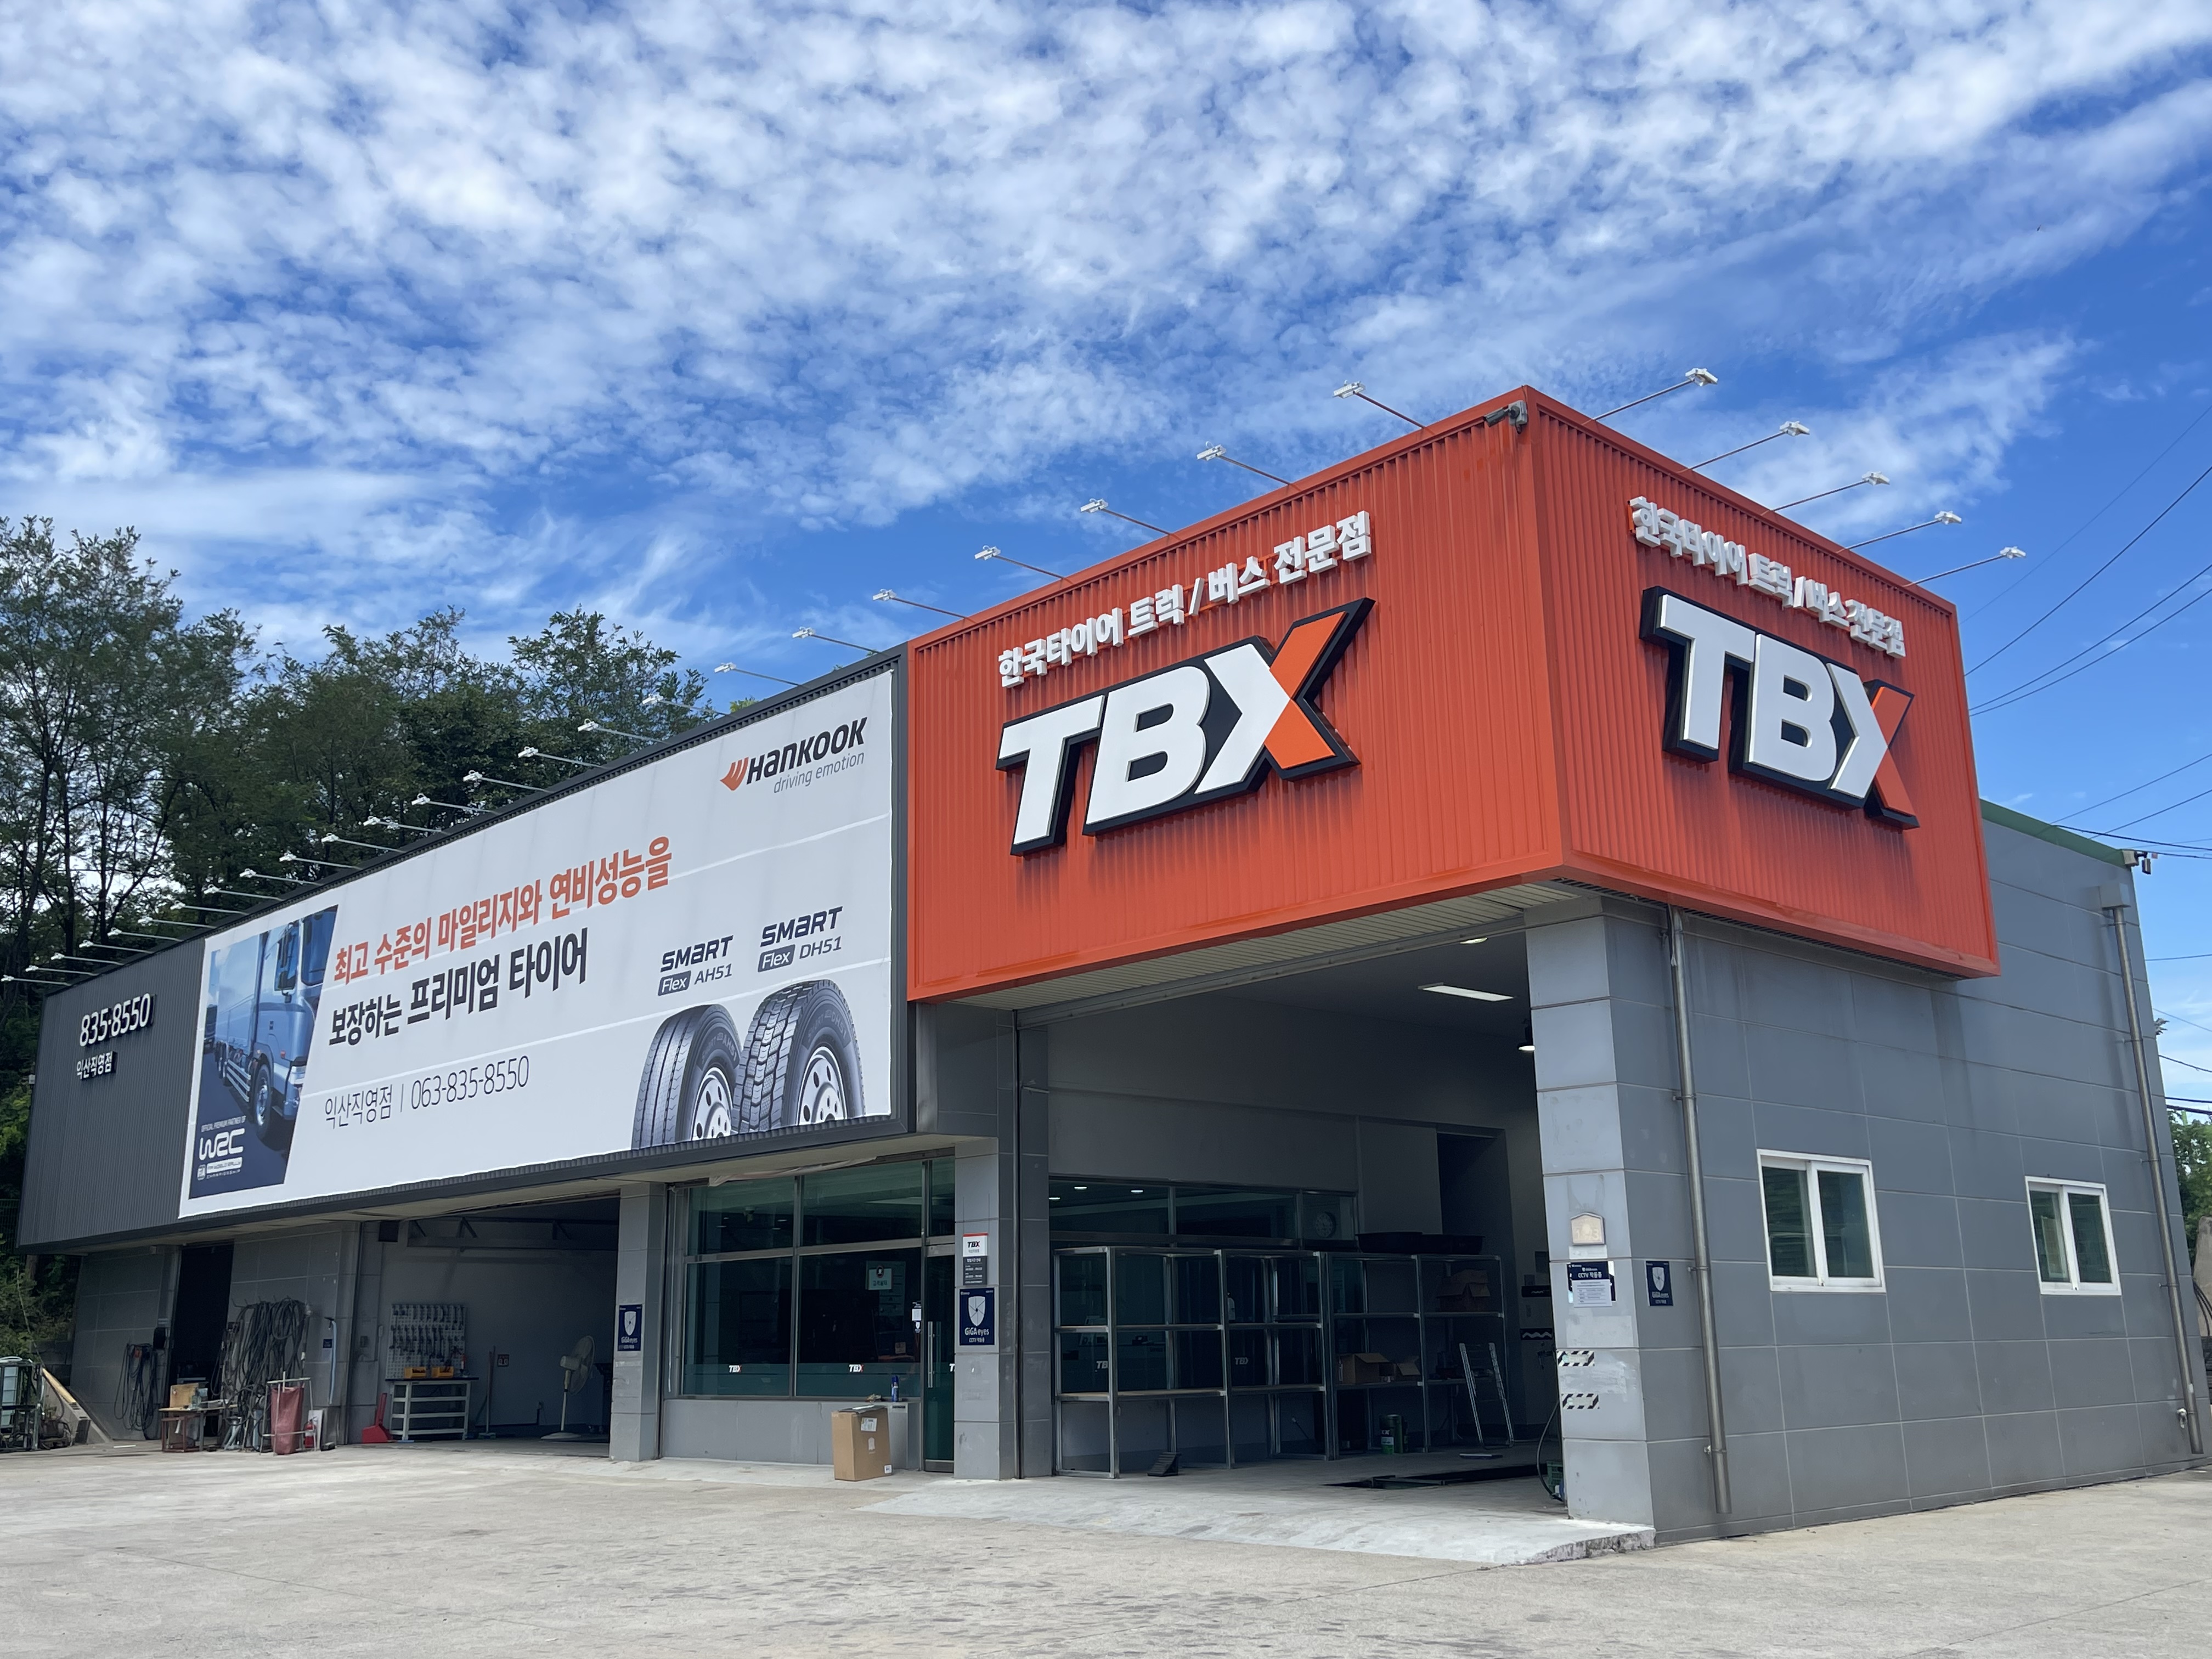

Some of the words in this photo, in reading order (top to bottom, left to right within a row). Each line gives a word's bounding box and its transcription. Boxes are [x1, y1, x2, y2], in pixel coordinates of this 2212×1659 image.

[1630, 496, 1748, 586] 한국타이어
[1748, 552, 1793, 609] 트럭
[1806, 579, 1850, 629] 버스
[1845, 599, 1906, 658] 전문점
[998, 607, 1124, 689] 한국타이어
[1127, 583, 1184, 637] 트럭
[1208, 555, 1271, 605] 버스
[1273, 510, 1372, 585] 전문점
[1656, 592, 1918, 819] TBX
[998, 610, 1348, 845] TBX
[774, 768, 812, 794] driving
[816, 752, 865, 780] emotion
[333, 940, 369, 985] 최고
[374, 917, 432, 970] 수준의
[437, 879, 543, 953] 마일리지와
[550, 836, 673, 920] 연비성능을
[760, 906, 843, 948] SMART
[660, 934, 734, 973] SMART
[761, 949, 790, 971] Flex
[799, 935, 843, 960] DH51
[328, 992, 402, 1047] 보장하는
[407, 953, 501, 1025] 프리미엄
[509, 926, 589, 999] 타이어
[661, 976, 688, 994] Flex
[694, 963, 733, 985] AH51
[76, 1051, 114, 1080] 익산직영점
[324, 1084, 393, 1129] 익산직영점
[410, 1055, 530, 1111] 063-835-8550
[199, 1128, 245, 1161] WRC
[849, 1364, 864, 1373] TBX
